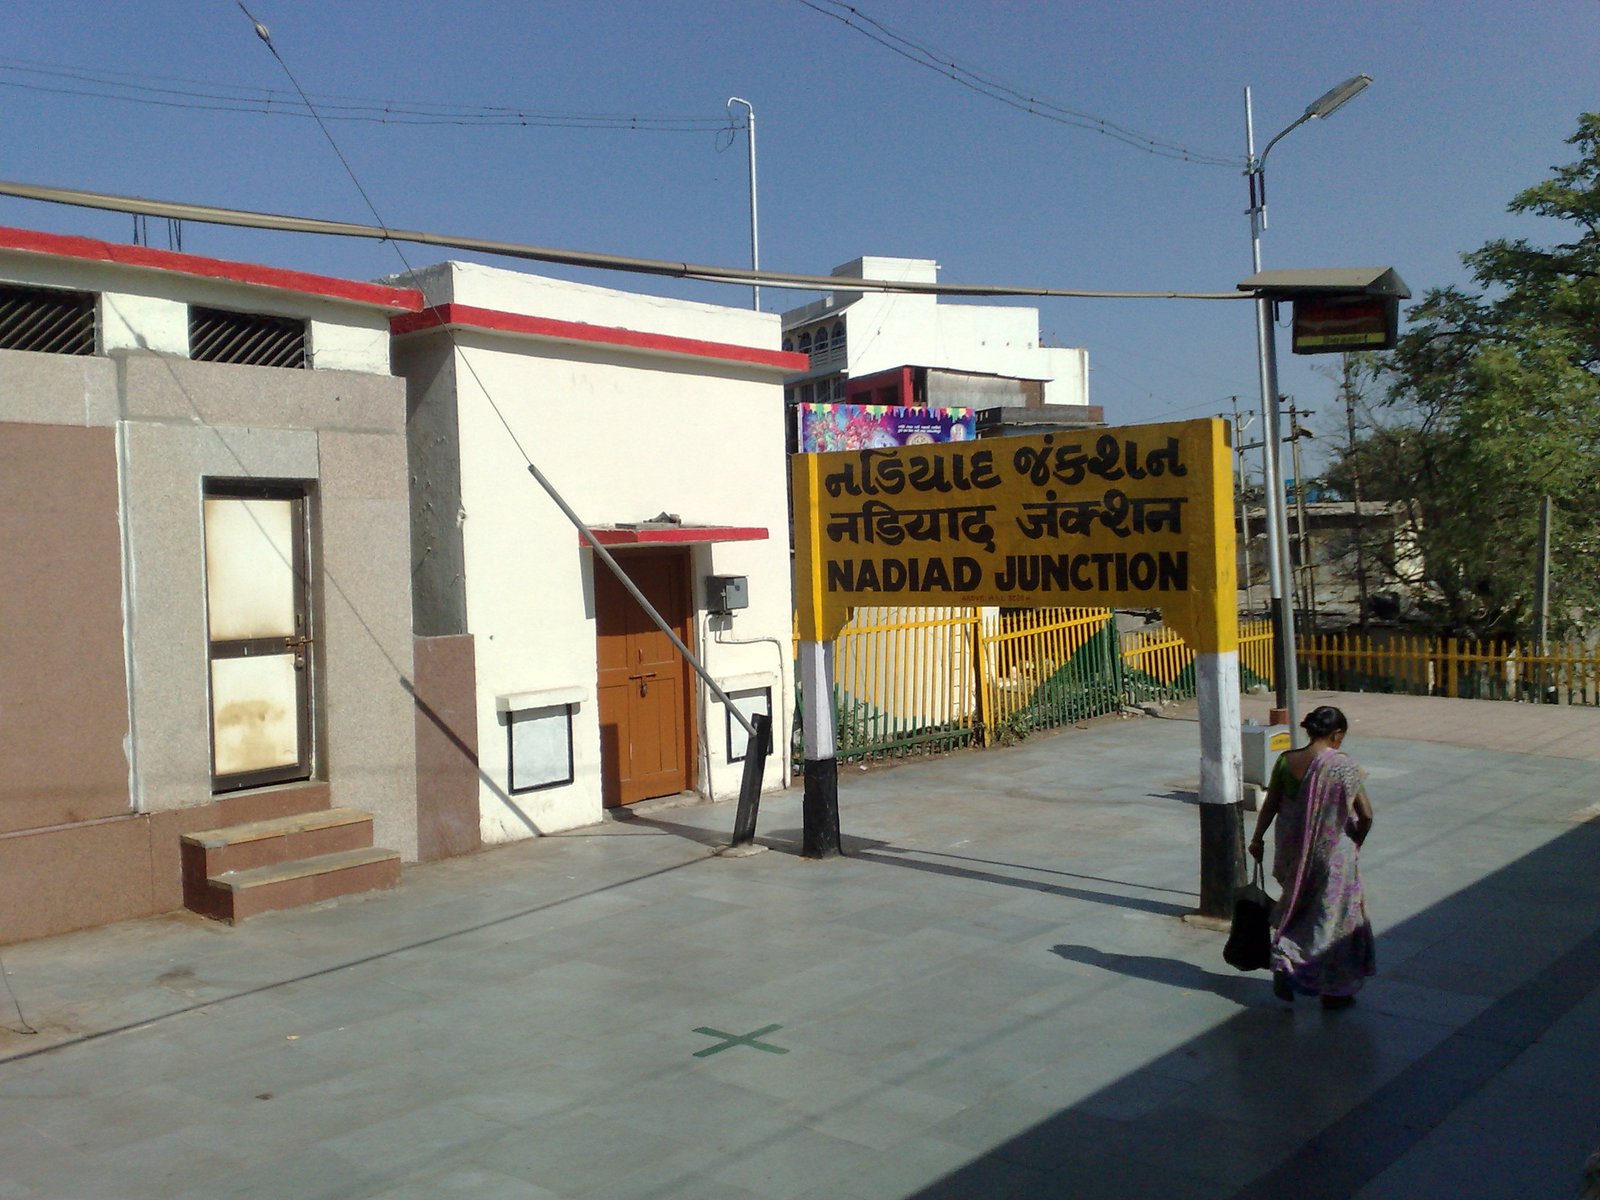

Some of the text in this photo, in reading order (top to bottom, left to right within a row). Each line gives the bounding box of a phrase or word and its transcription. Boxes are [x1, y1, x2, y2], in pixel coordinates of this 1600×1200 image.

[824, 448, 1002, 498] નડિયાદ
[826, 500, 998, 554] नडियाद
[827, 550, 1189, 593] NADIAD JUNCTION
